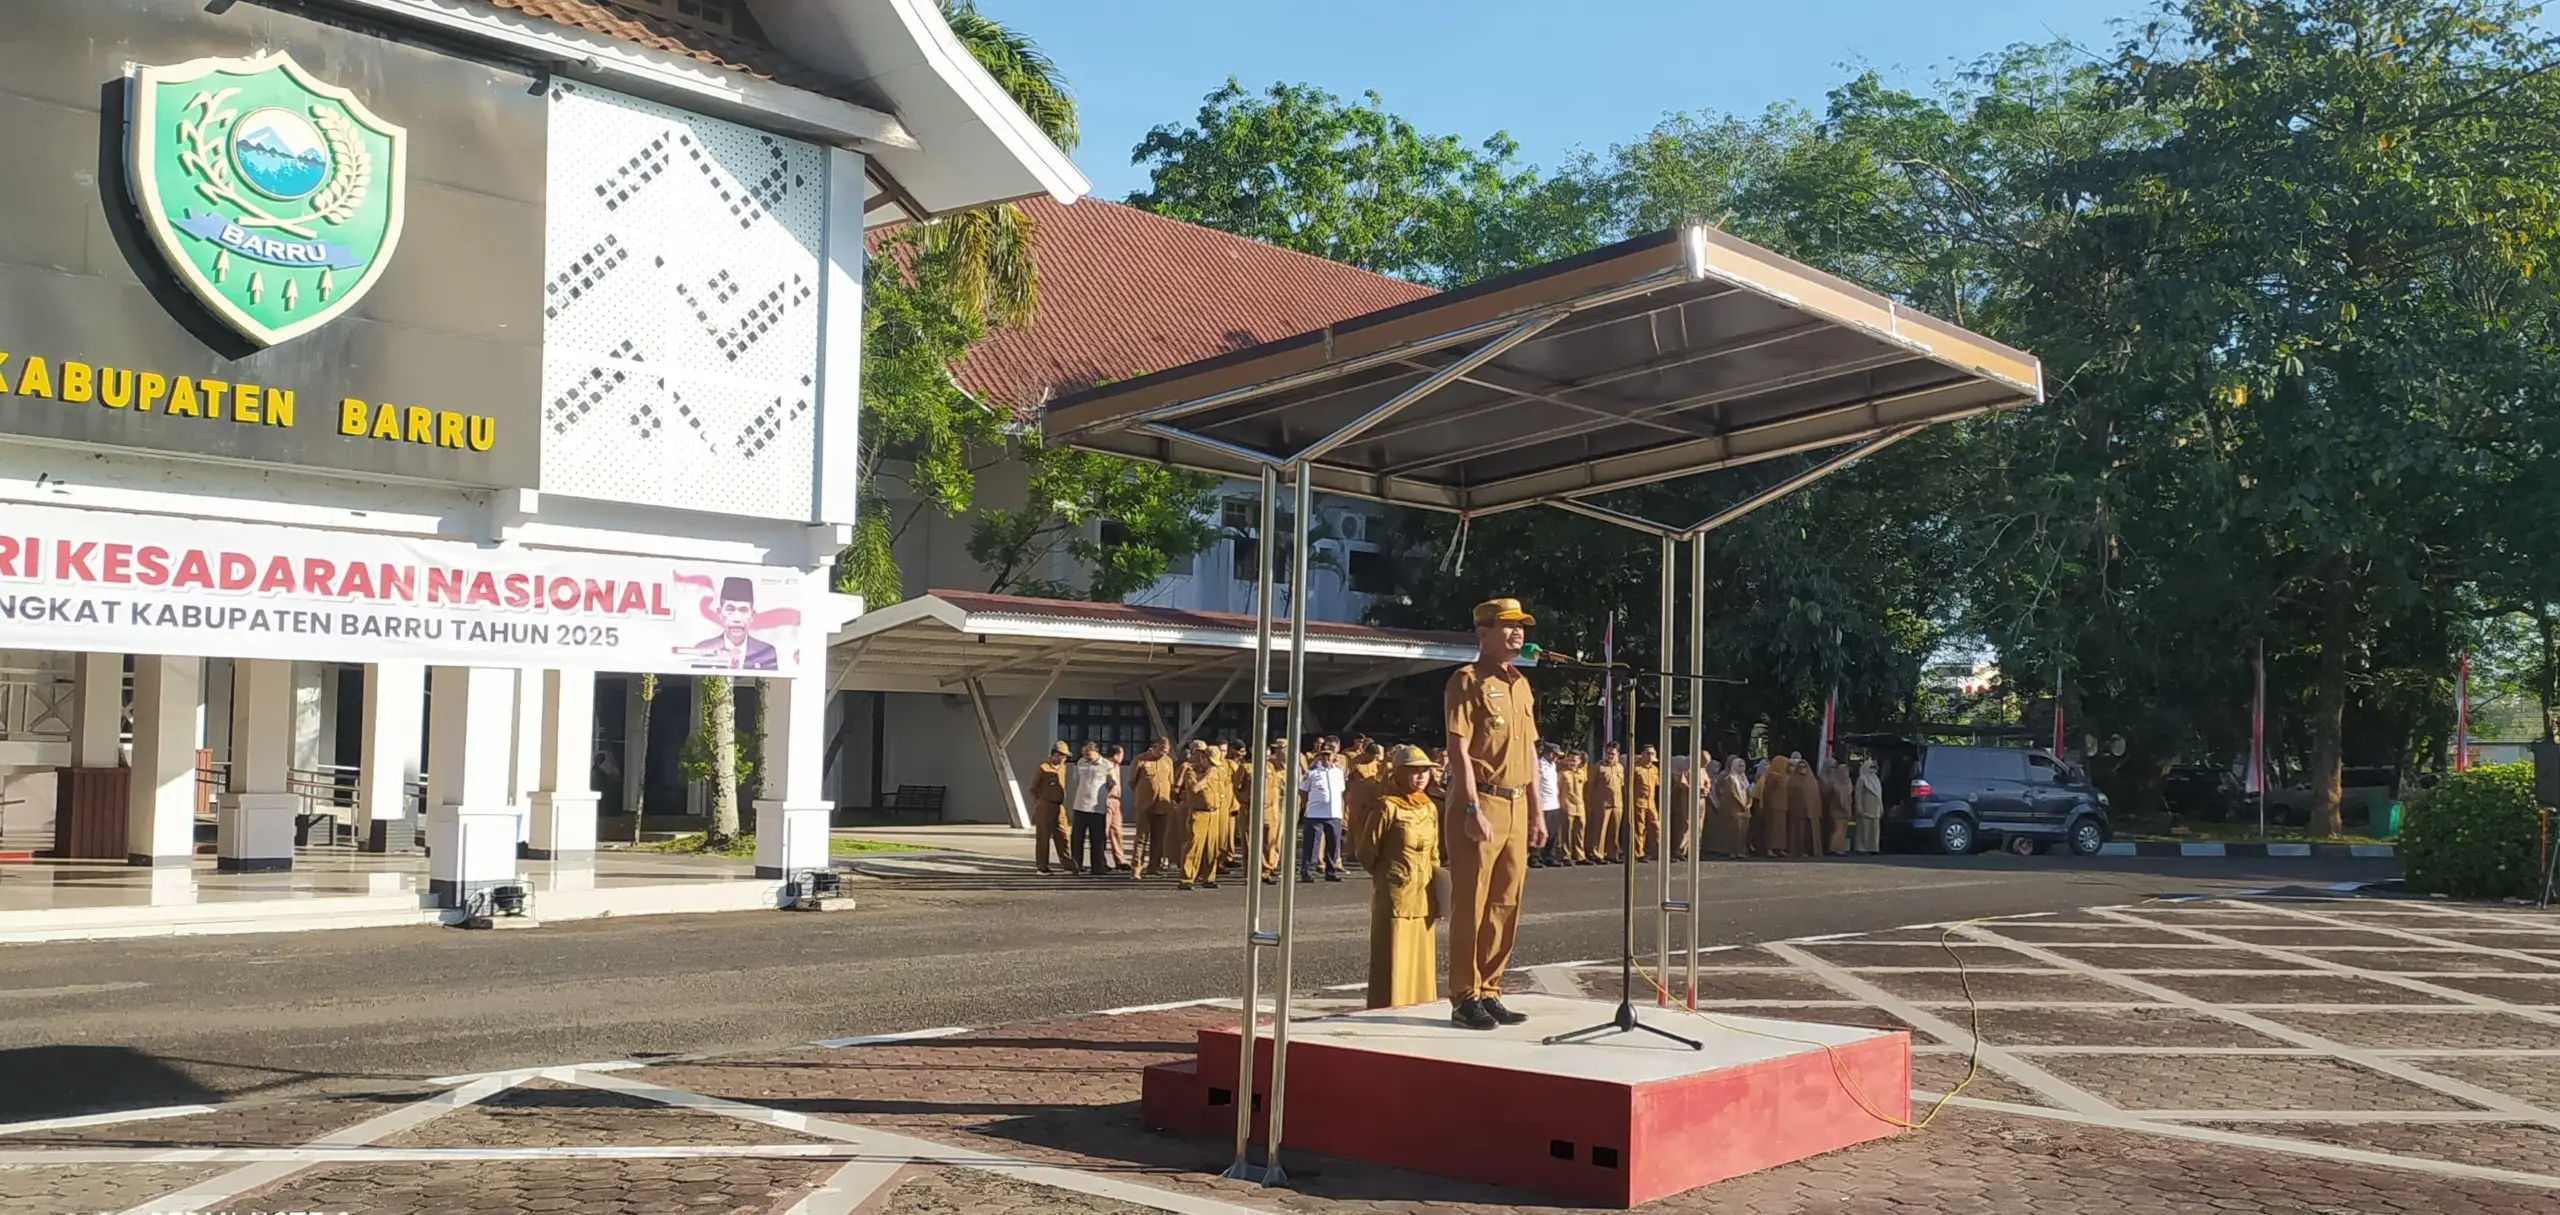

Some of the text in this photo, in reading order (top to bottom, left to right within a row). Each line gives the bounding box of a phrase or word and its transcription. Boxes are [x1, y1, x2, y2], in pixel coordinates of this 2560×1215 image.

[220, 223, 327, 262] BARRU
[0, 352, 495, 451] ABUPATEN BARRU
[56, 539, 415, 602] KESADARAN
[427, 567, 671, 616] NASIONAL
[131, 602, 331, 635] KABUPATEN
[341, 613, 443, 640] BARRU
[450, 619, 549, 645] TAHUN
[556, 624, 619, 647] 2025
